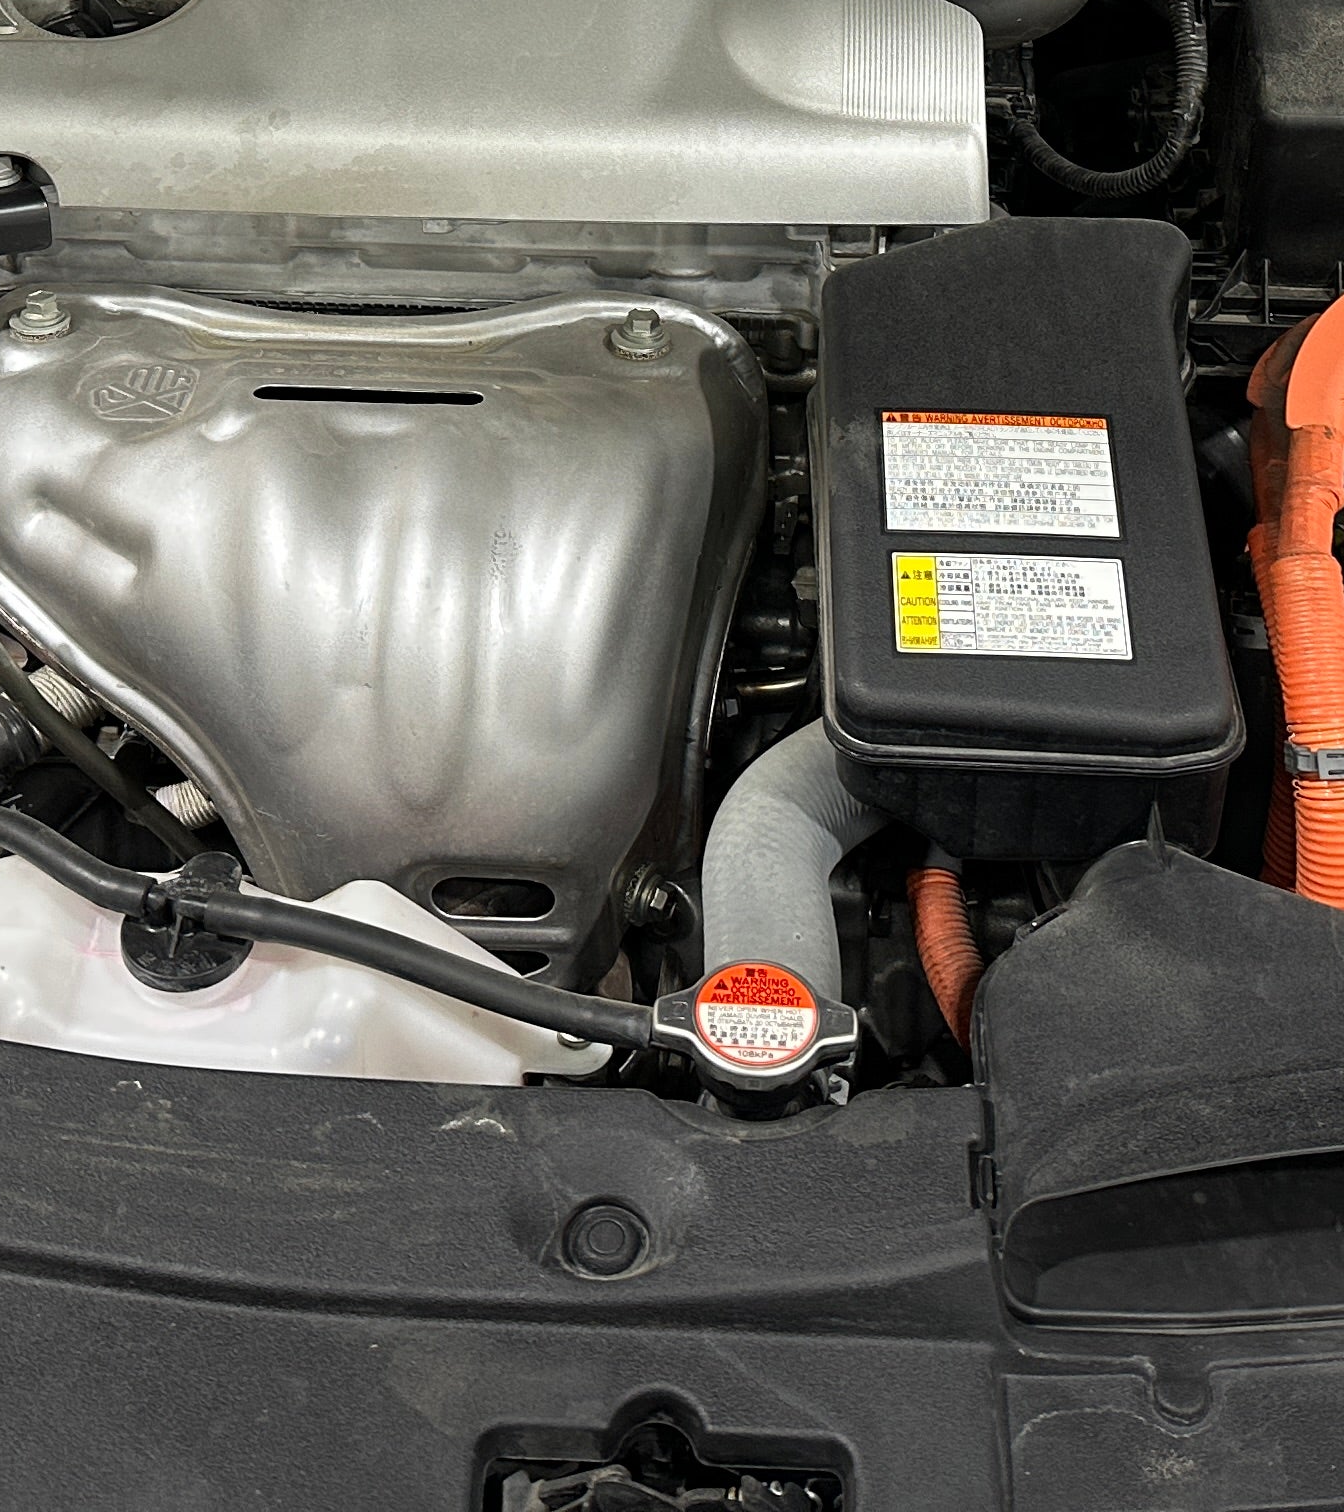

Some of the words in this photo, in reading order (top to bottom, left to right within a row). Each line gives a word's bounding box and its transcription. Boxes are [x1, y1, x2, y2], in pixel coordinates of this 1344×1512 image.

[925, 413, 969, 424] WARNING
[971, 414, 1046, 427] AVERTISSEMENT
[900, 596, 937, 607] CAUTION
[901, 615, 938, 626] ATTENTION
[730, 976, 789, 988] WARNING
[710, 992, 802, 1006] AVERTISSEMENT
